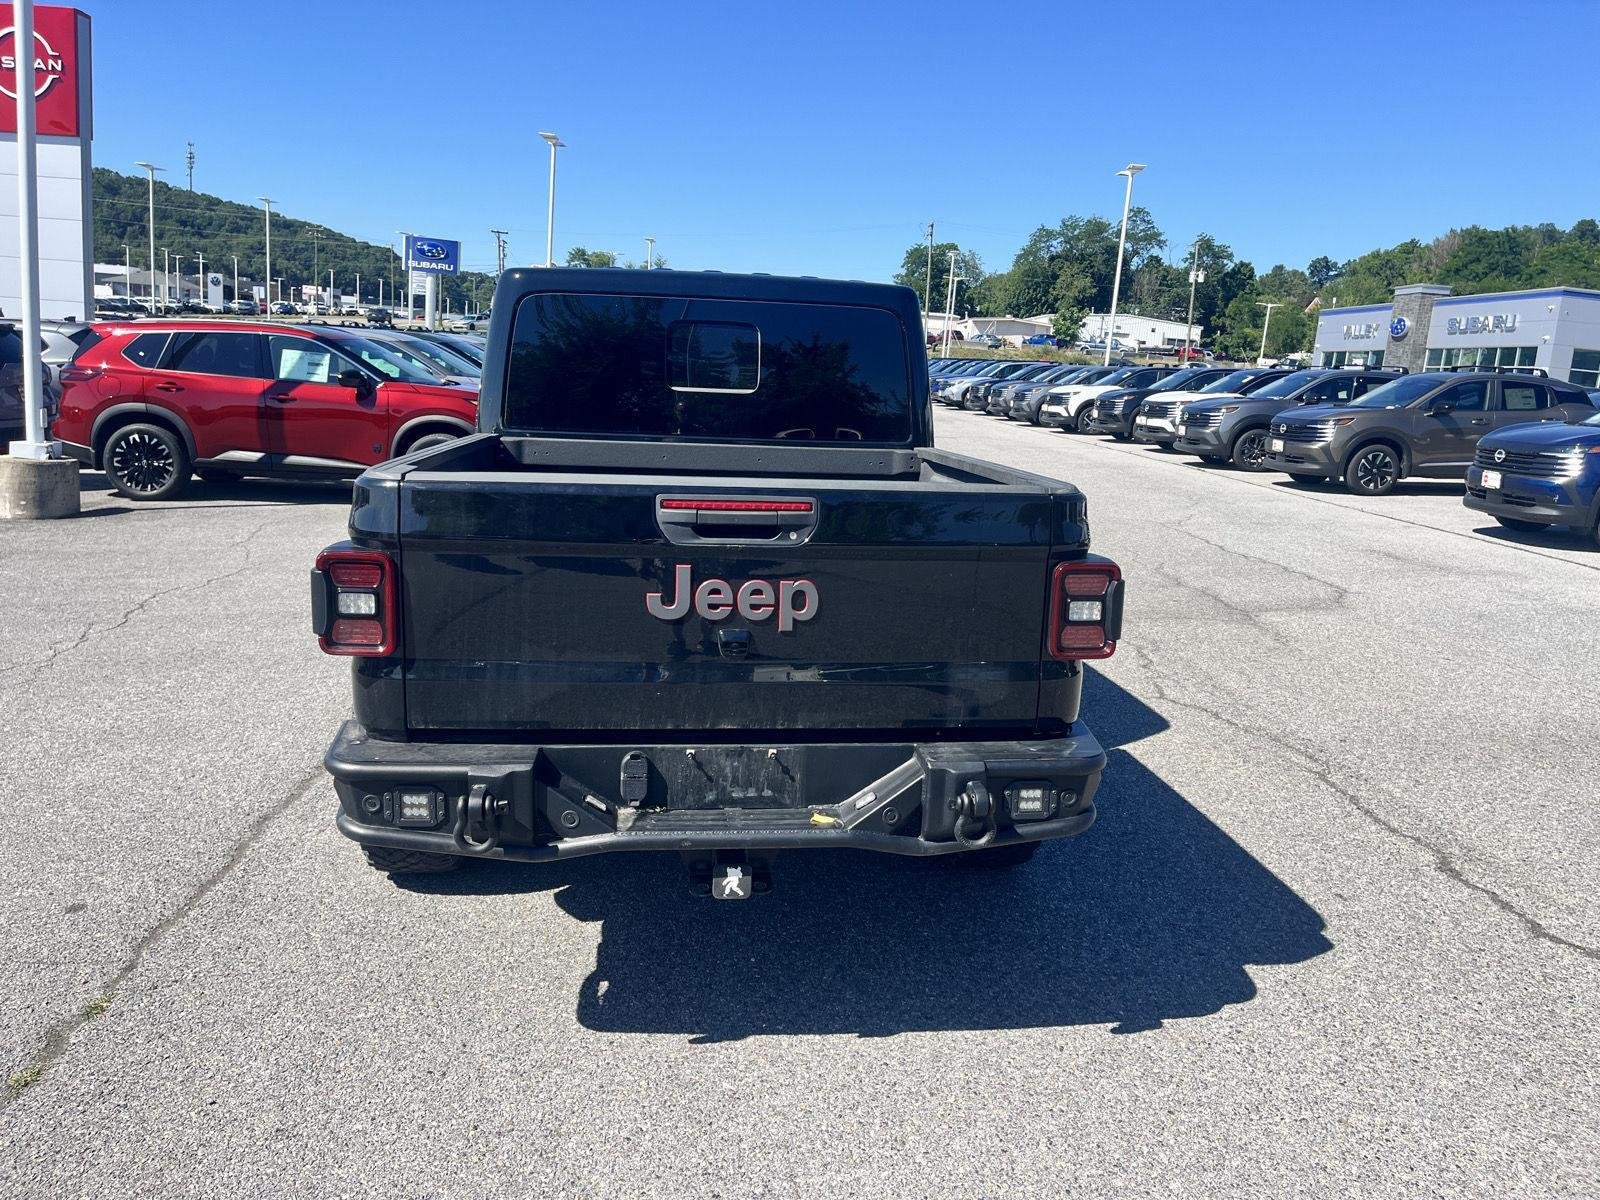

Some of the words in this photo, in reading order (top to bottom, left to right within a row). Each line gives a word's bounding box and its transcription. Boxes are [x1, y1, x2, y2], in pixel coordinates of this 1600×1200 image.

[1, 56, 61, 71] SAN
[408, 260, 453, 271] SUBARU
[1343, 323, 1380, 340] VALLEY
[1447, 313, 1517, 335] SUBARU
[646, 564, 819, 633] Jeep
